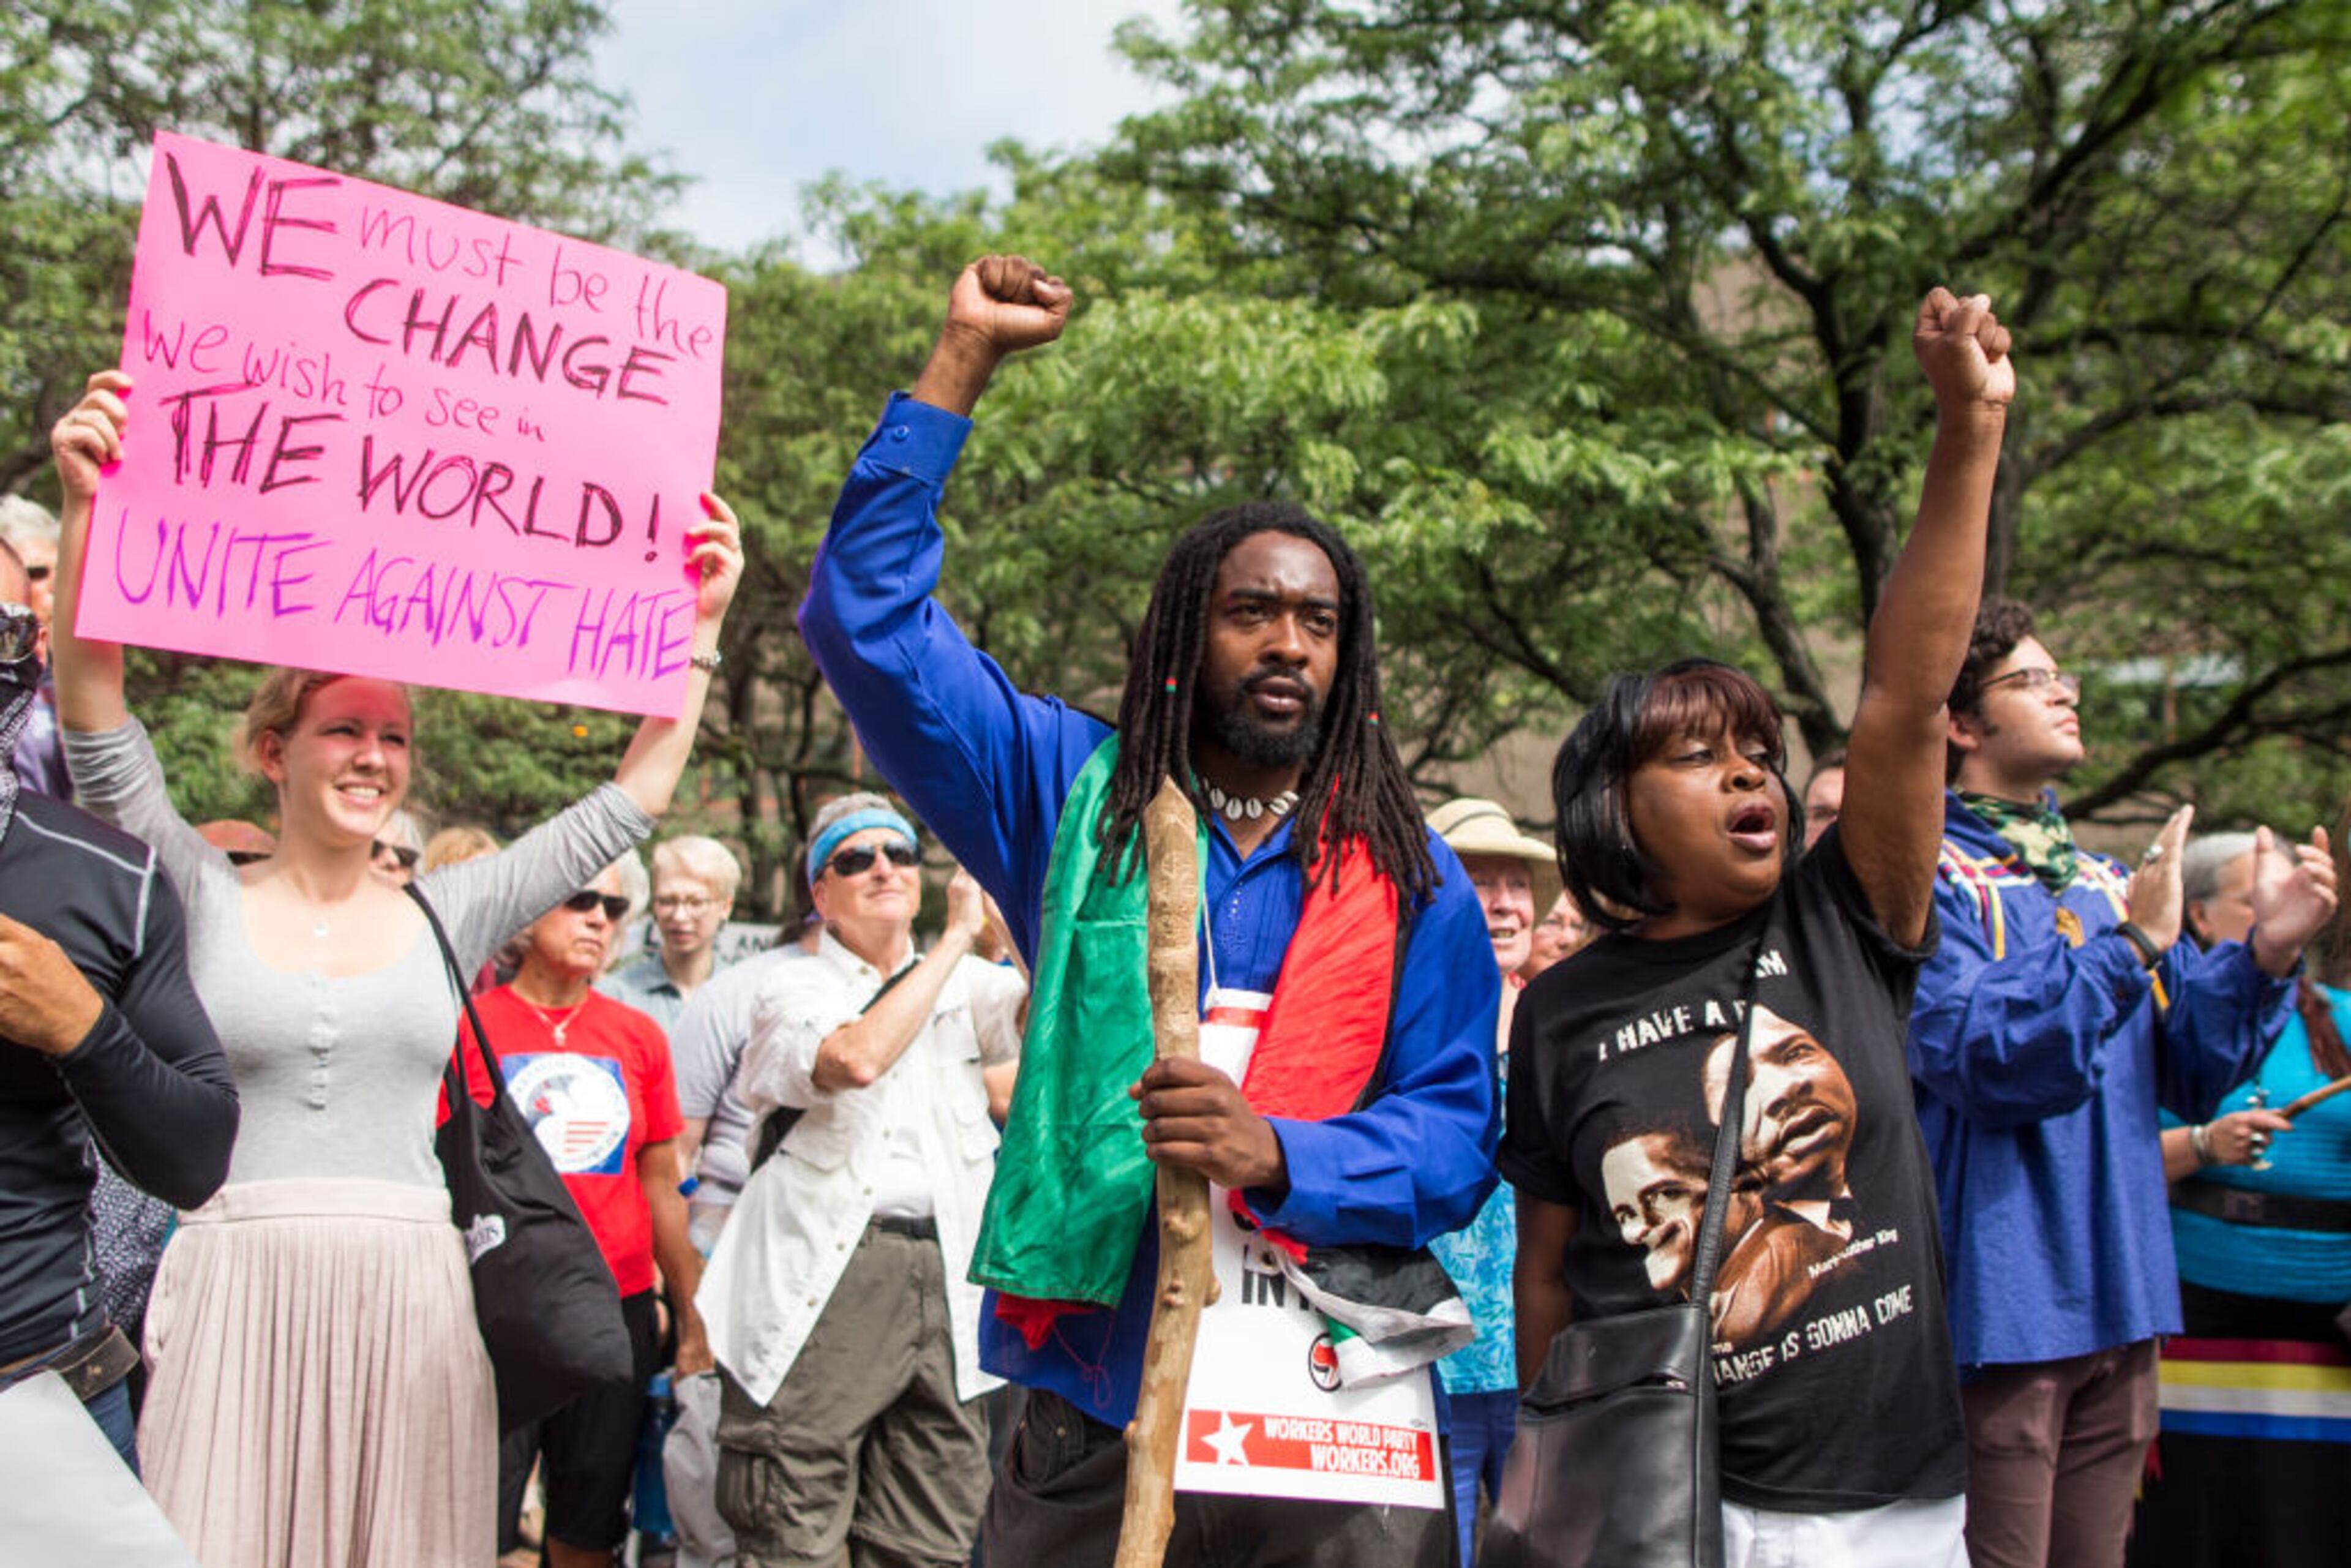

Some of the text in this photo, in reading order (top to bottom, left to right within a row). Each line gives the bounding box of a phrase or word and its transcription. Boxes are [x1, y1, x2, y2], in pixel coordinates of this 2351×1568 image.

[165, 151, 342, 281] WE
[550, 244, 609, 313] be
[633, 273, 713, 358] the
[242, 341, 347, 407] wish
[364, 361, 404, 419] to
[424, 387, 500, 435] see
[517, 405, 546, 442] in
[344, 277, 677, 406] CHANGE
[158, 377, 349, 495] THE
[116, 506, 698, 681] UNITE AGAINST HATE
[1616, 1005, 1694, 1052] HAVE
[1705, 999, 1727, 1027] A
[1781, 1330, 1801, 1362] IS
[1806, 1305, 1872, 1351] GONNA
[1875, 1285, 1914, 1326] COME
[1263, 1416, 1334, 1443] WORKERS
[1336, 1422, 1381, 1447] WORLD
[1381, 1427, 1419, 1452] PARTY
[1310, 1443, 1420, 1479] WORKERS.ORG
